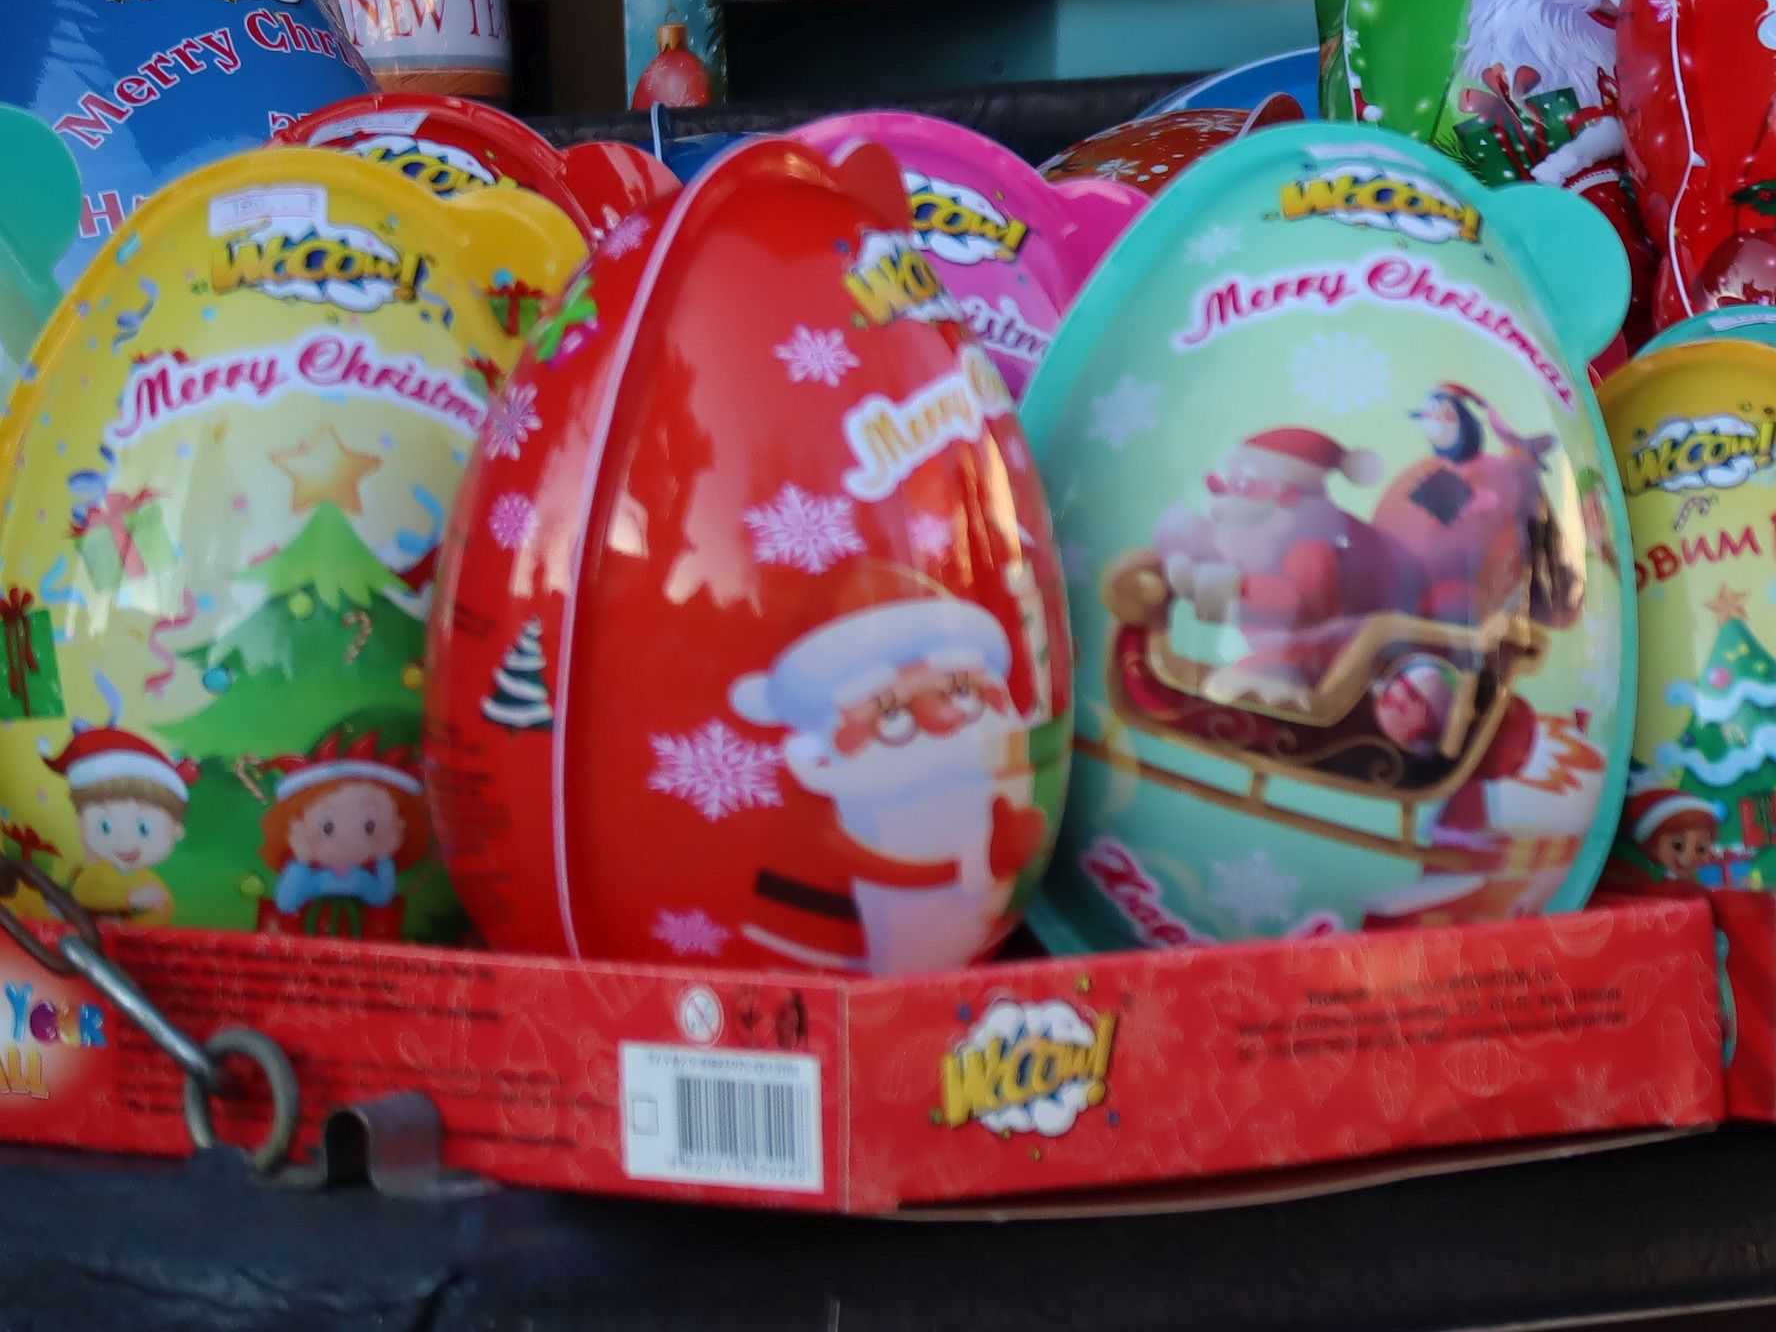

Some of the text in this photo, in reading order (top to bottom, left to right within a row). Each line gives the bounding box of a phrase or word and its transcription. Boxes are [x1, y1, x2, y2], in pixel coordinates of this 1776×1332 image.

[53, 26, 242, 150] Merry
[113, 335, 483, 438] Merry Christm
[1179, 256, 1576, 412] Merry Christmas
